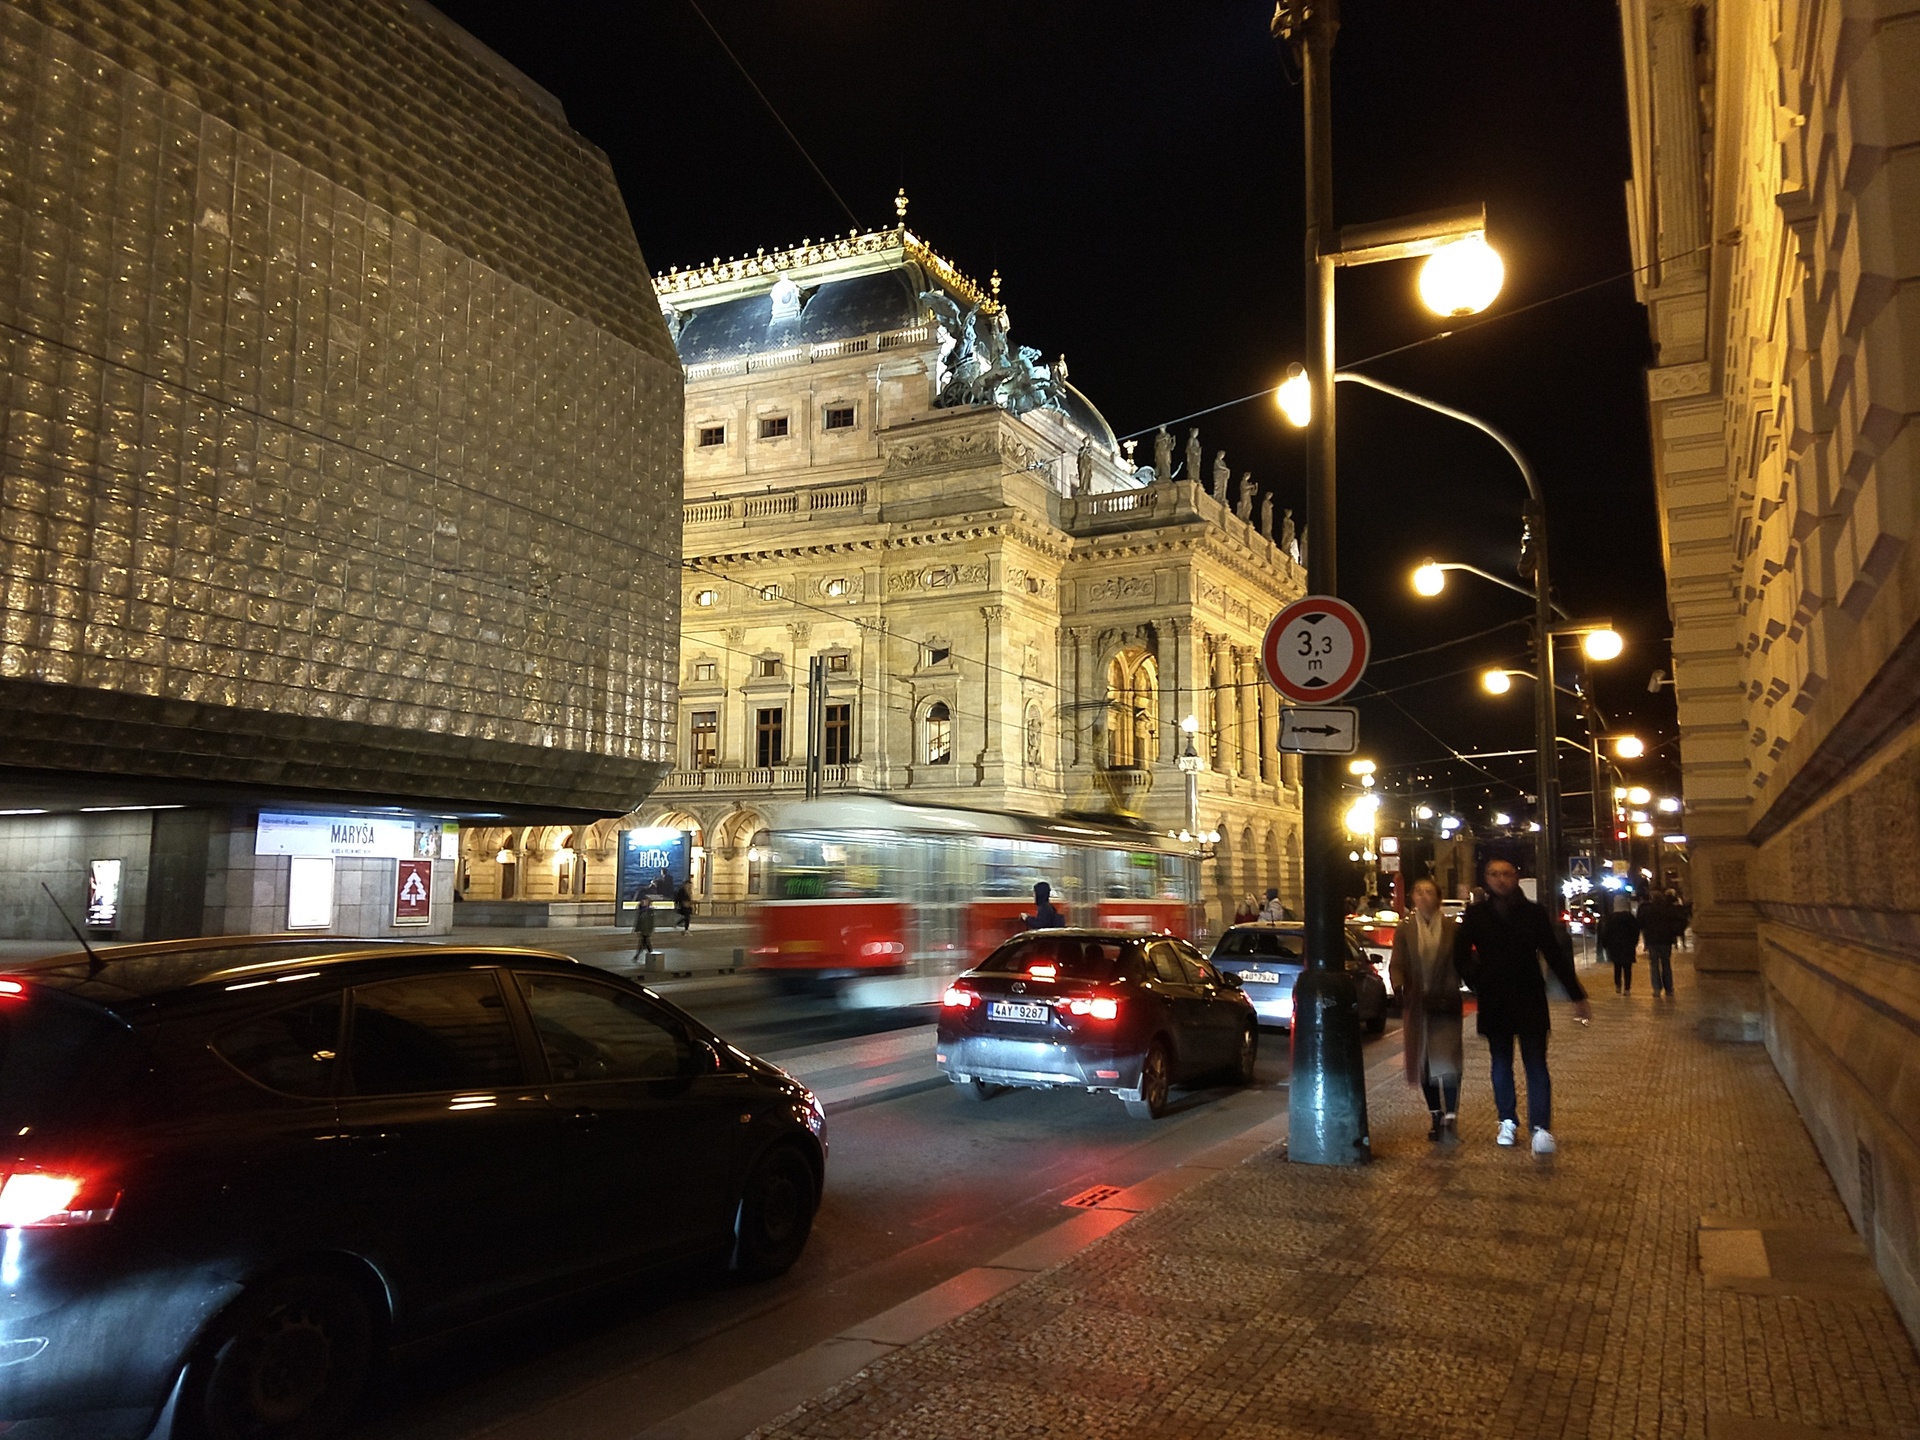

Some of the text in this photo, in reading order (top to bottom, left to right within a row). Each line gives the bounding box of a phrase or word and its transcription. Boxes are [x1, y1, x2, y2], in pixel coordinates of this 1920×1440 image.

[1298, 631, 1332, 656] 3,3
[1308, 659, 1323, 670] m
[331, 822, 375, 844] MARYŠA
[639, 857, 670, 868] BUDD
[995, 1004, 1044, 1019] 4AY 9287
